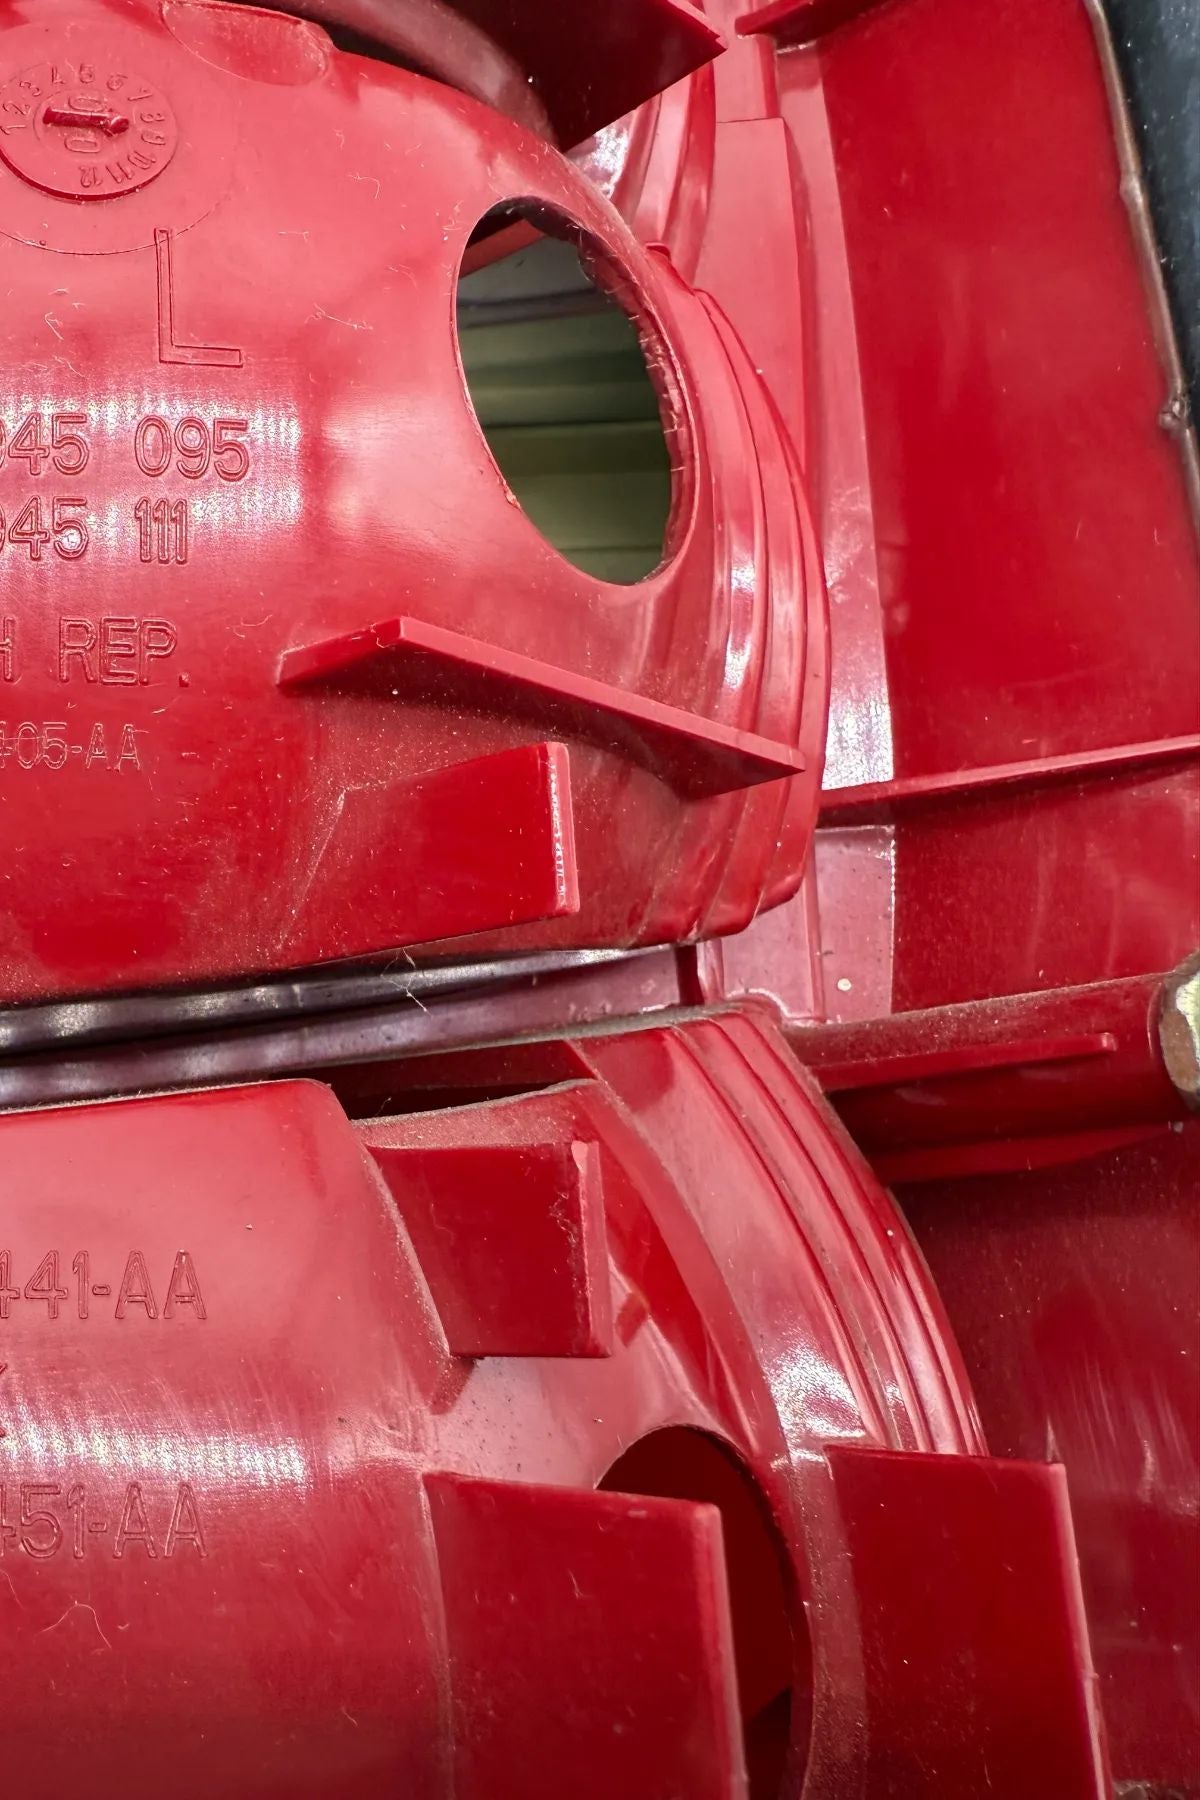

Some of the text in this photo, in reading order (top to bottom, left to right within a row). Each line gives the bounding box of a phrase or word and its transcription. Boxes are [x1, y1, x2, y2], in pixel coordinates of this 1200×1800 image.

[0, 63, 166, 188] 1 2 3 4 5 6 7 8 9 10 11 12
[154, 228, 243, 368] L
[134, 419, 250, 482] 095
[134, 497, 188, 565] 111
[59, 616, 191, 687] REP.
